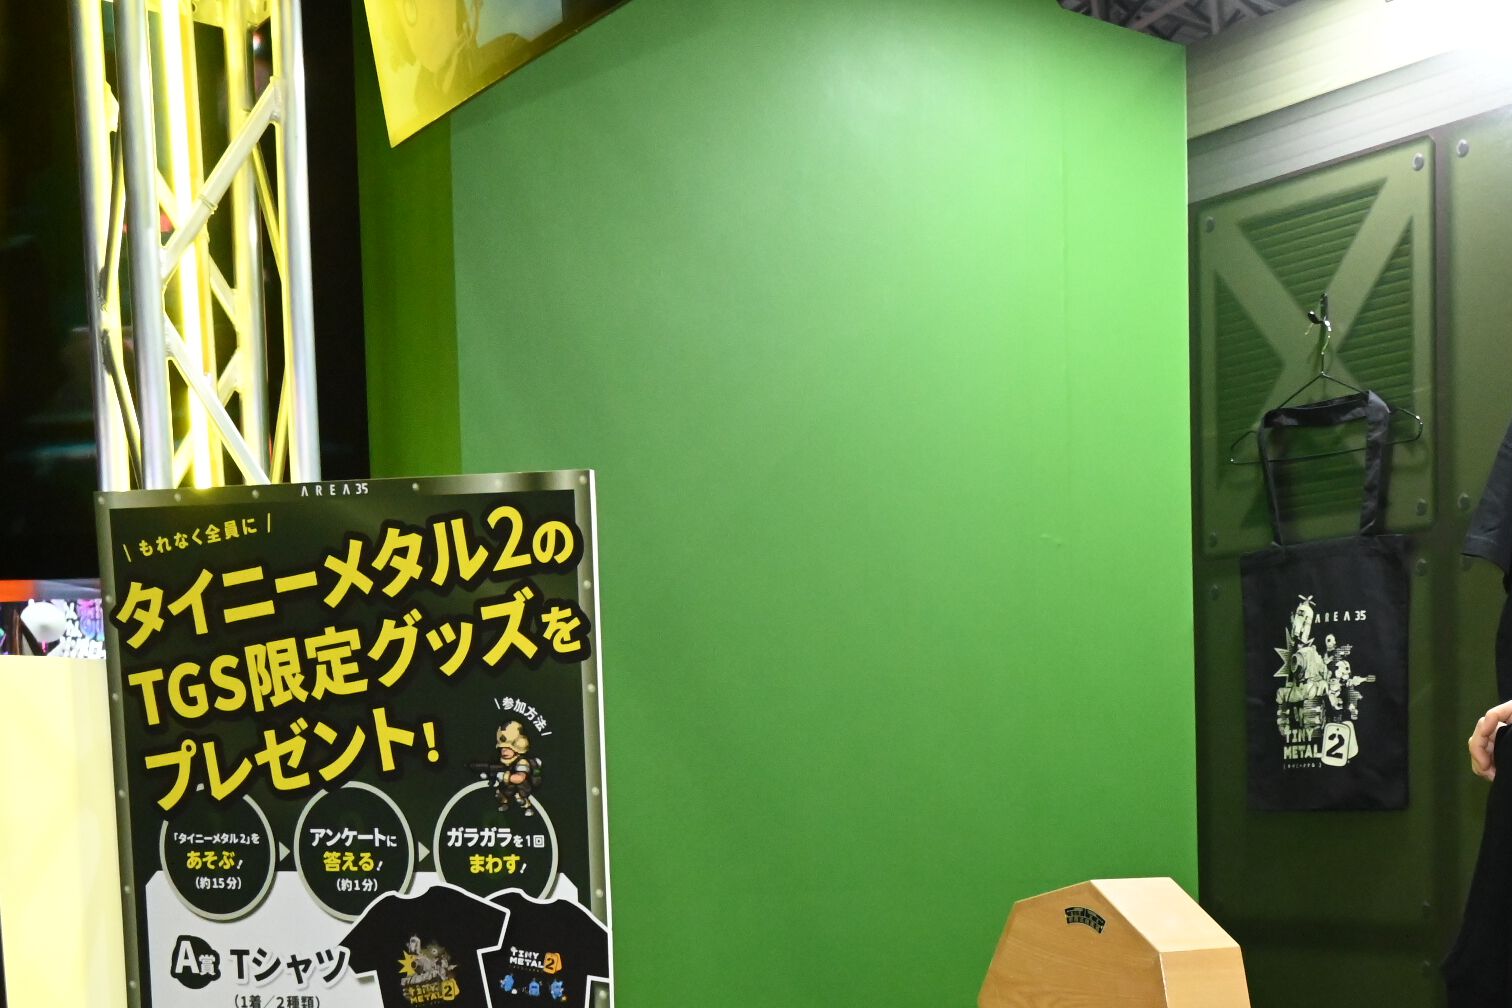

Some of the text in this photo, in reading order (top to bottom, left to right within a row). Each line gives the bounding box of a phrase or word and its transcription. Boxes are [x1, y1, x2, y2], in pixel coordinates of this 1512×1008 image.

[301, 483, 368, 497] AREA 35
[139, 518, 258, 557] もれなく全員に
[116, 505, 574, 650] タイニーメタル2の
[1354, 610, 1366, 621] 35
[128, 586, 582, 726] TGS限定グッズを
[502, 696, 547, 733] 参加方法
[1284, 733, 1345, 759] METAL 2
[309, 827, 397, 847] アンケートに
[447, 826, 545, 848] ガラガラを1回
[229, 947, 346, 985] Tシャツ
[509, 956, 545, 969] METAL
